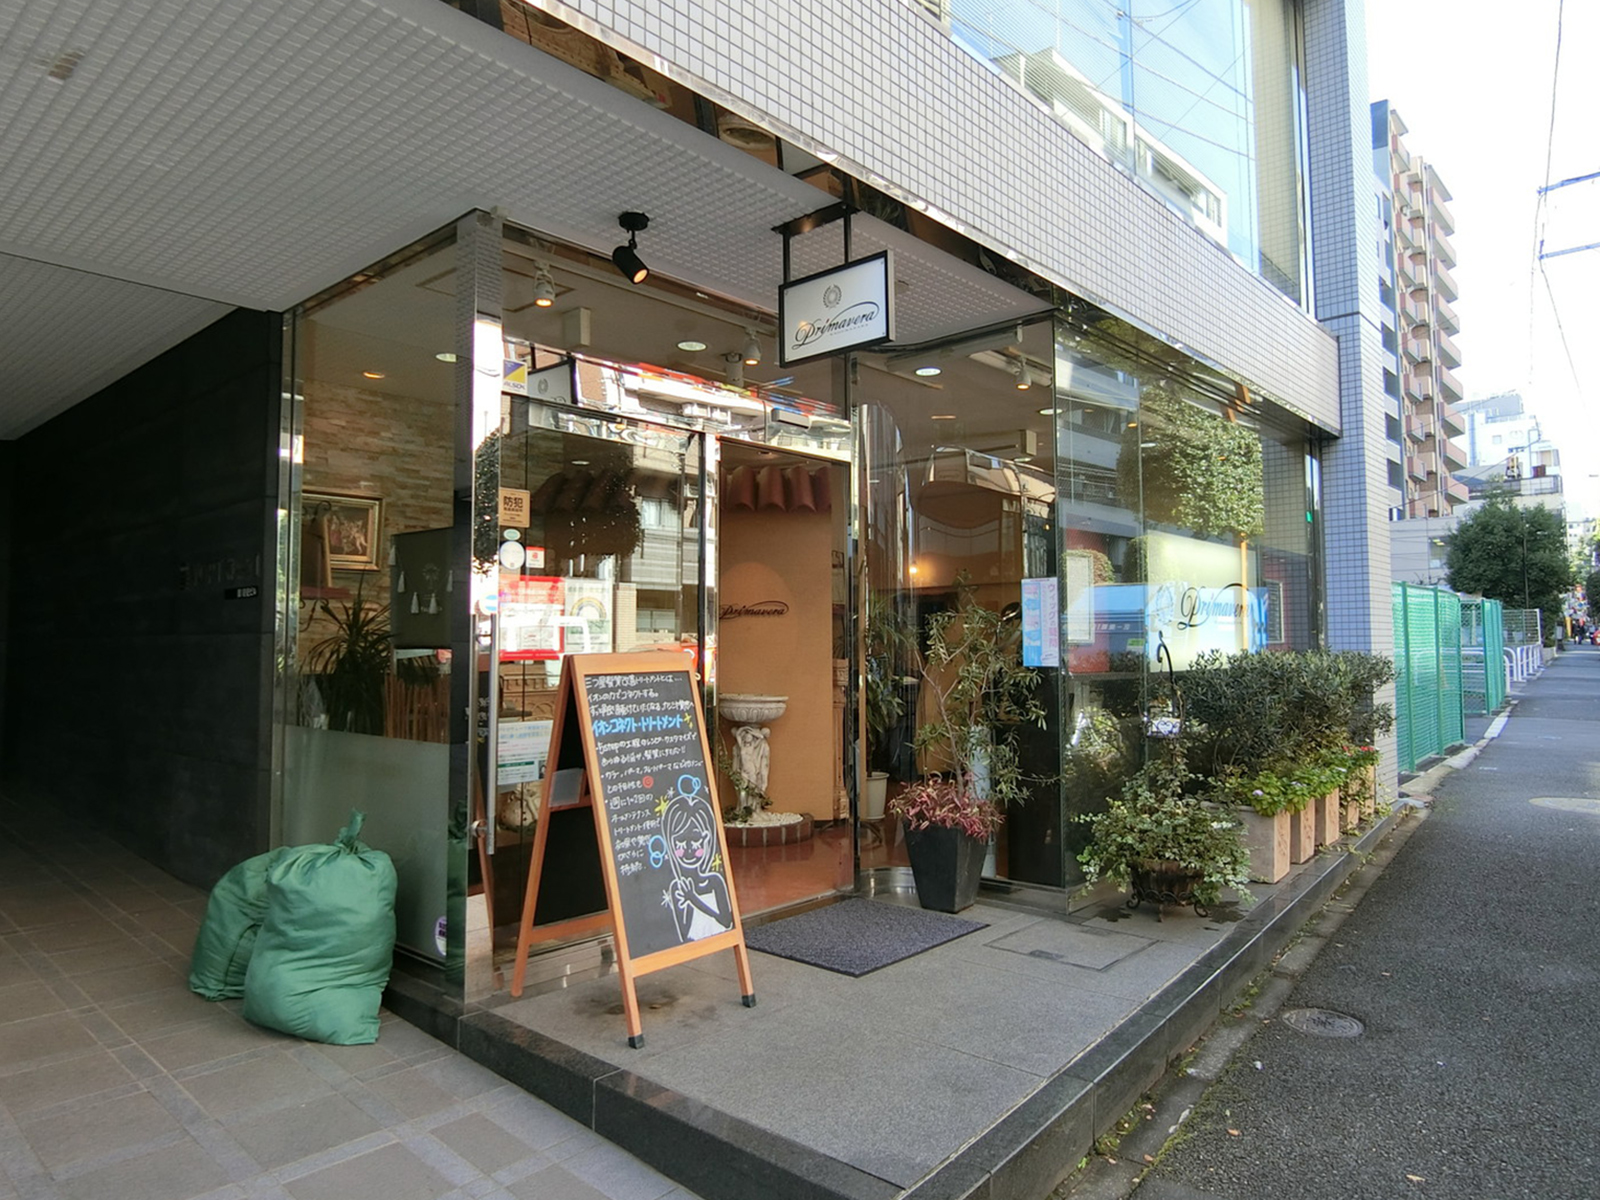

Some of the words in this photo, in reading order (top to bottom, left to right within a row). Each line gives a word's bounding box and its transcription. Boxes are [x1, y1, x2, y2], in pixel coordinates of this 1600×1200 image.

[791, 301, 880, 350] Primavera
[503, 496, 523, 508] 防犯
[592, 713, 684, 737] イオンコネクト・トリートメント
